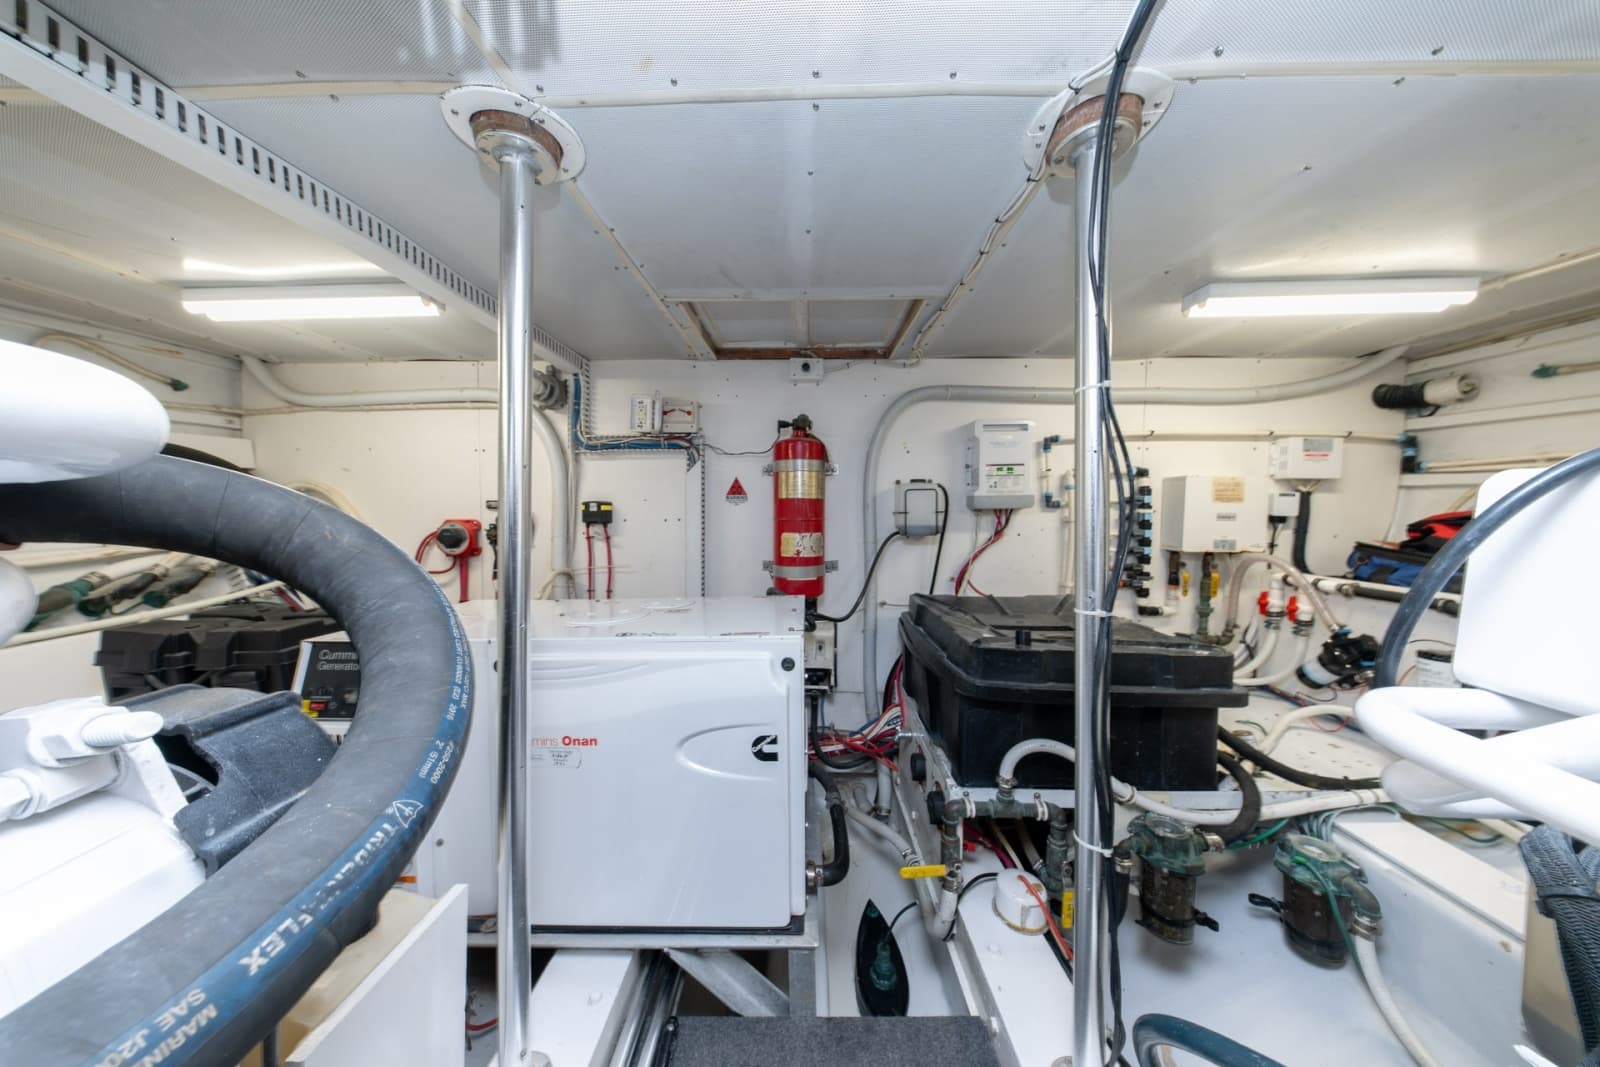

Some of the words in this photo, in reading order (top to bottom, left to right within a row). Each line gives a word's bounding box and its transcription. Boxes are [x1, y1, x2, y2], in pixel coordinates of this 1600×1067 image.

[318, 660, 360, 671] Generato
[531, 736, 560, 747] mins
[561, 735, 599, 747] Onan
[153, 987, 207, 1033] SAE
